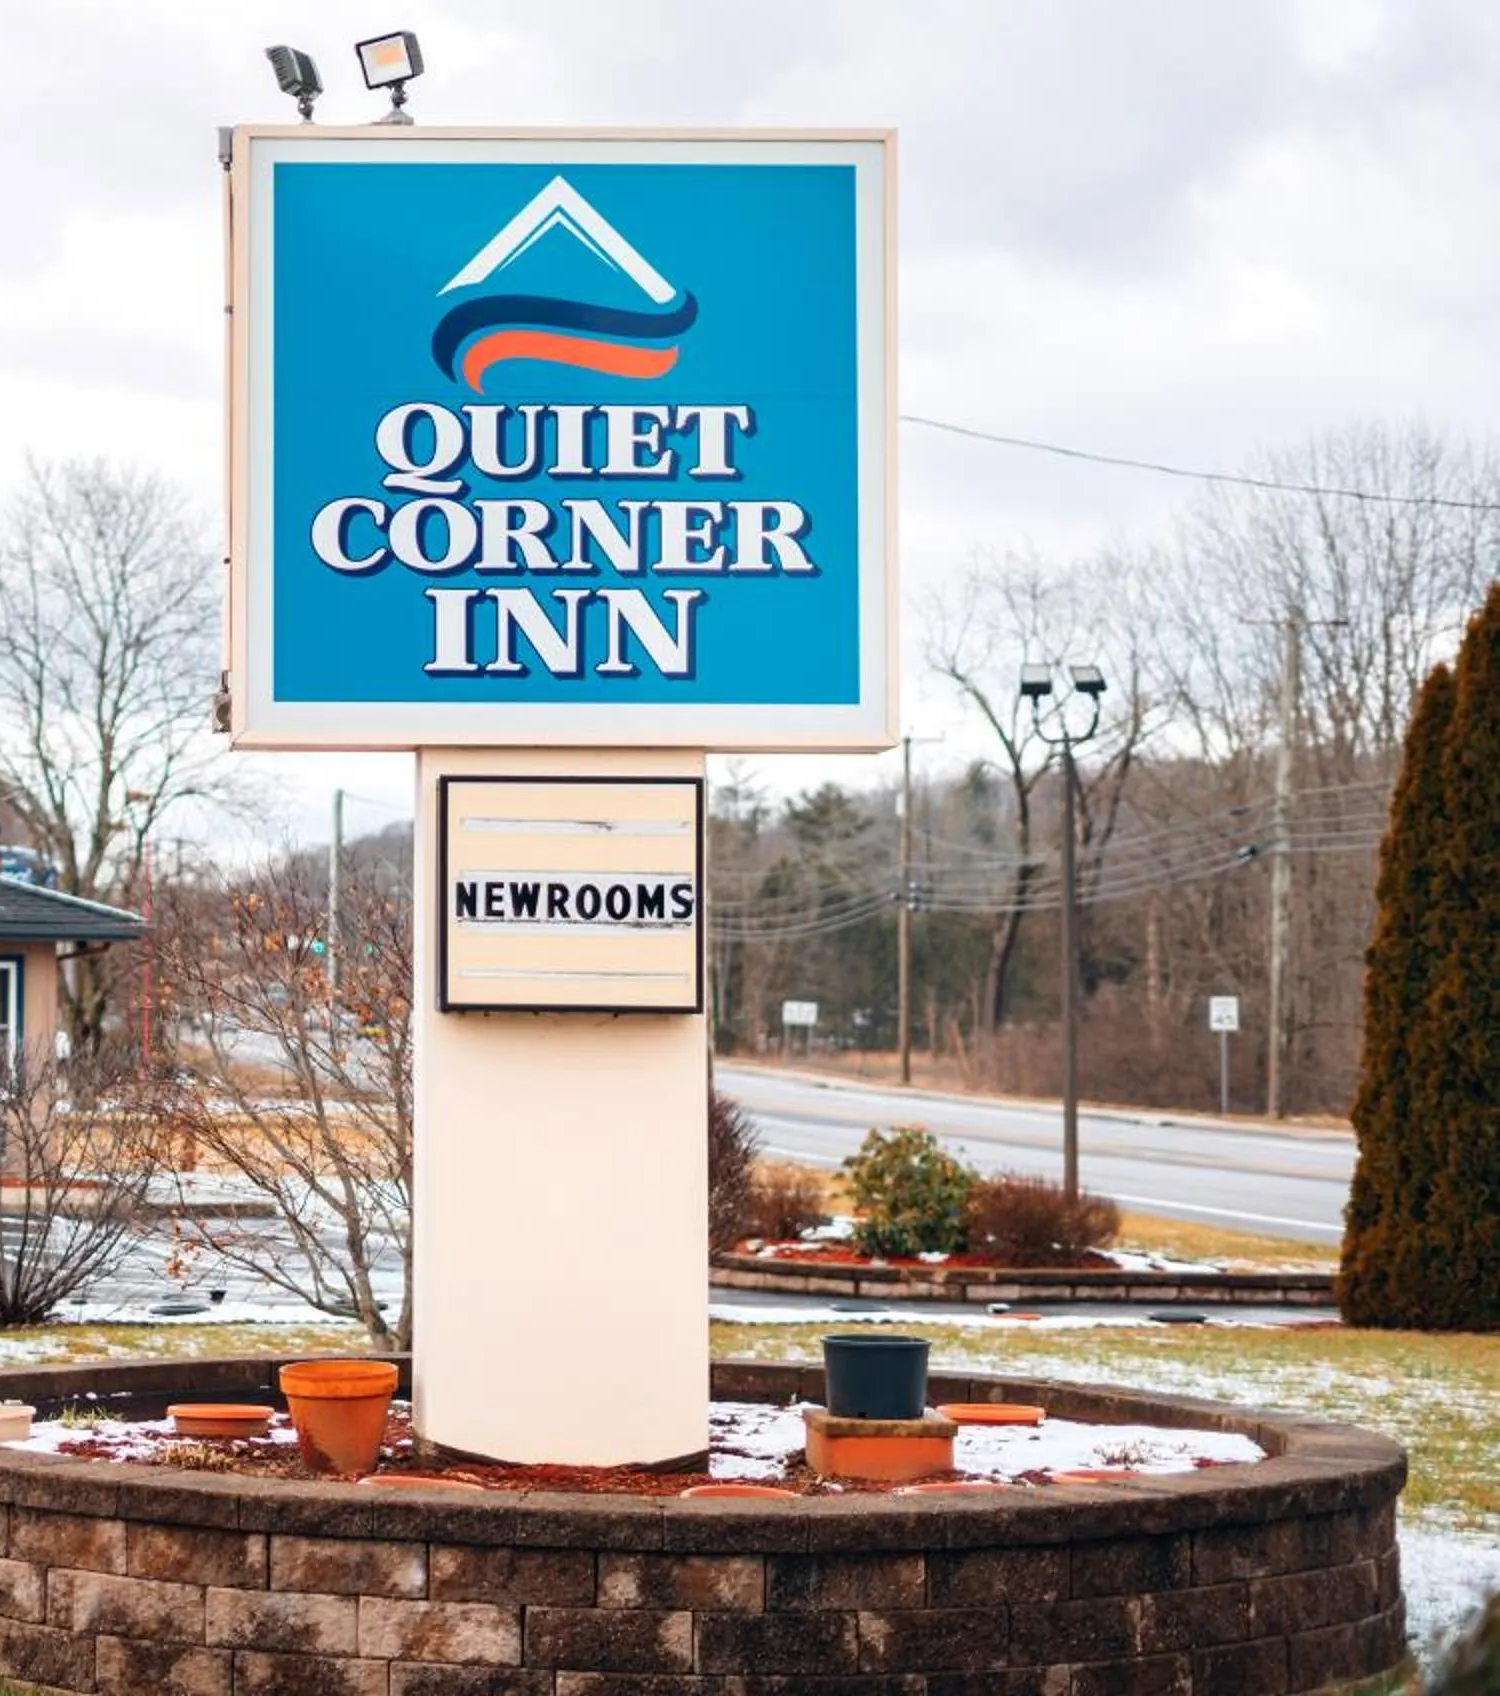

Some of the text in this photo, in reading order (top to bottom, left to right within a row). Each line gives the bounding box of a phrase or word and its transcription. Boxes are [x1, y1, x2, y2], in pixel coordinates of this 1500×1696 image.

[374, 401, 757, 496] QUIET
[310, 497, 821, 577] CORNER
[424, 585, 710, 680] INN
